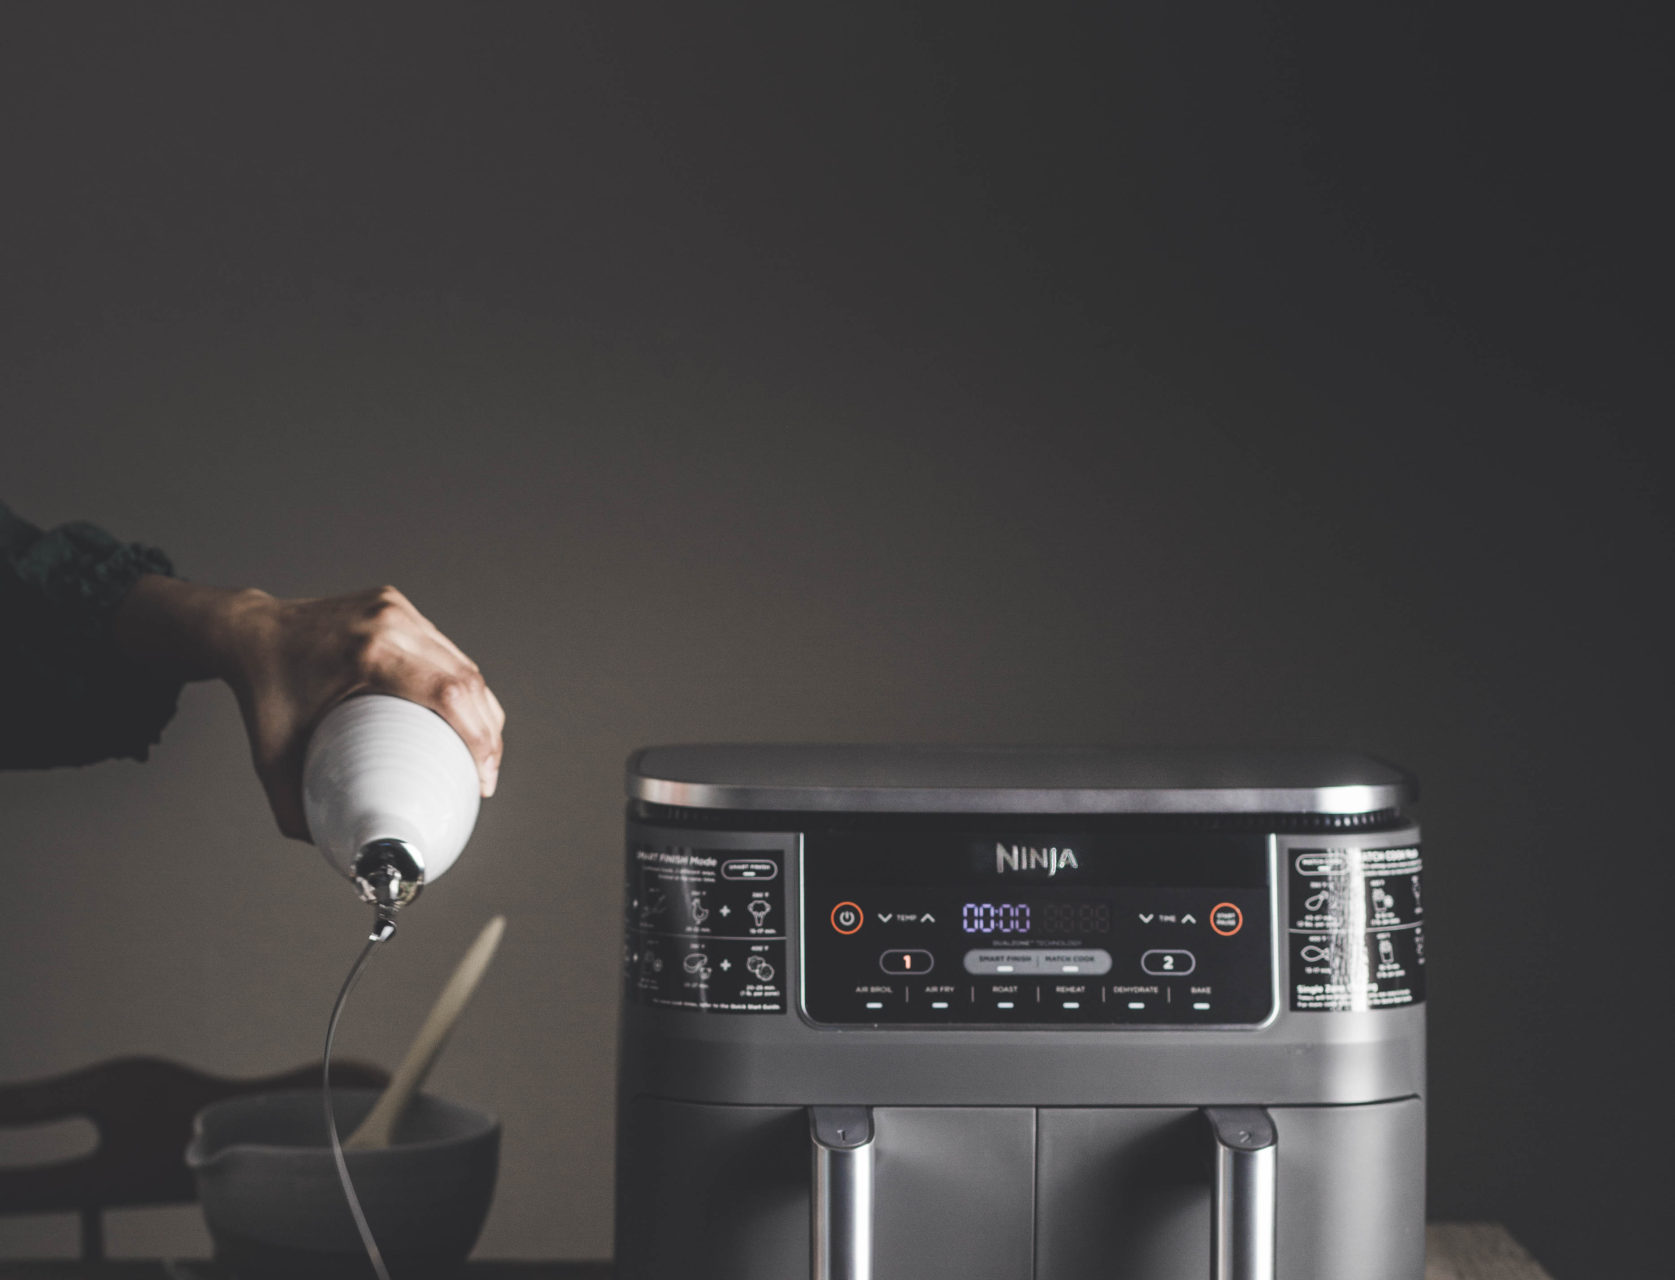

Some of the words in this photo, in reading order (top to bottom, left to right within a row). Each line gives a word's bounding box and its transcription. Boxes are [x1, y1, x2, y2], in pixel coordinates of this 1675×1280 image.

[690, 855, 717, 867] Mode
[996, 842, 1078, 877] NINJA
[962, 903, 1031, 933] 00:00
[1159, 914, 1177, 922] TIME
[902, 954, 912, 970] 1
[978, 955, 1005, 963] SMART
[1006, 955, 1032, 963] FINISH
[1044, 955, 1072, 963] MATCH
[1073, 955, 1095, 963] COOK
[1162, 955, 1175, 970] 2
[855, 985, 870, 993] AIR
[870, 985, 893, 993] BROIL
[925, 985, 939, 993] AIR
[939, 985, 955, 993] FRY
[992, 985, 1018, 993] ROAST
[1055, 985, 1085, 993] REHEAT
[1113, 985, 1159, 994] DEHYDRATE
[1190, 986, 1212, 994] BAKE
[1297, 984, 1324, 995] Single
